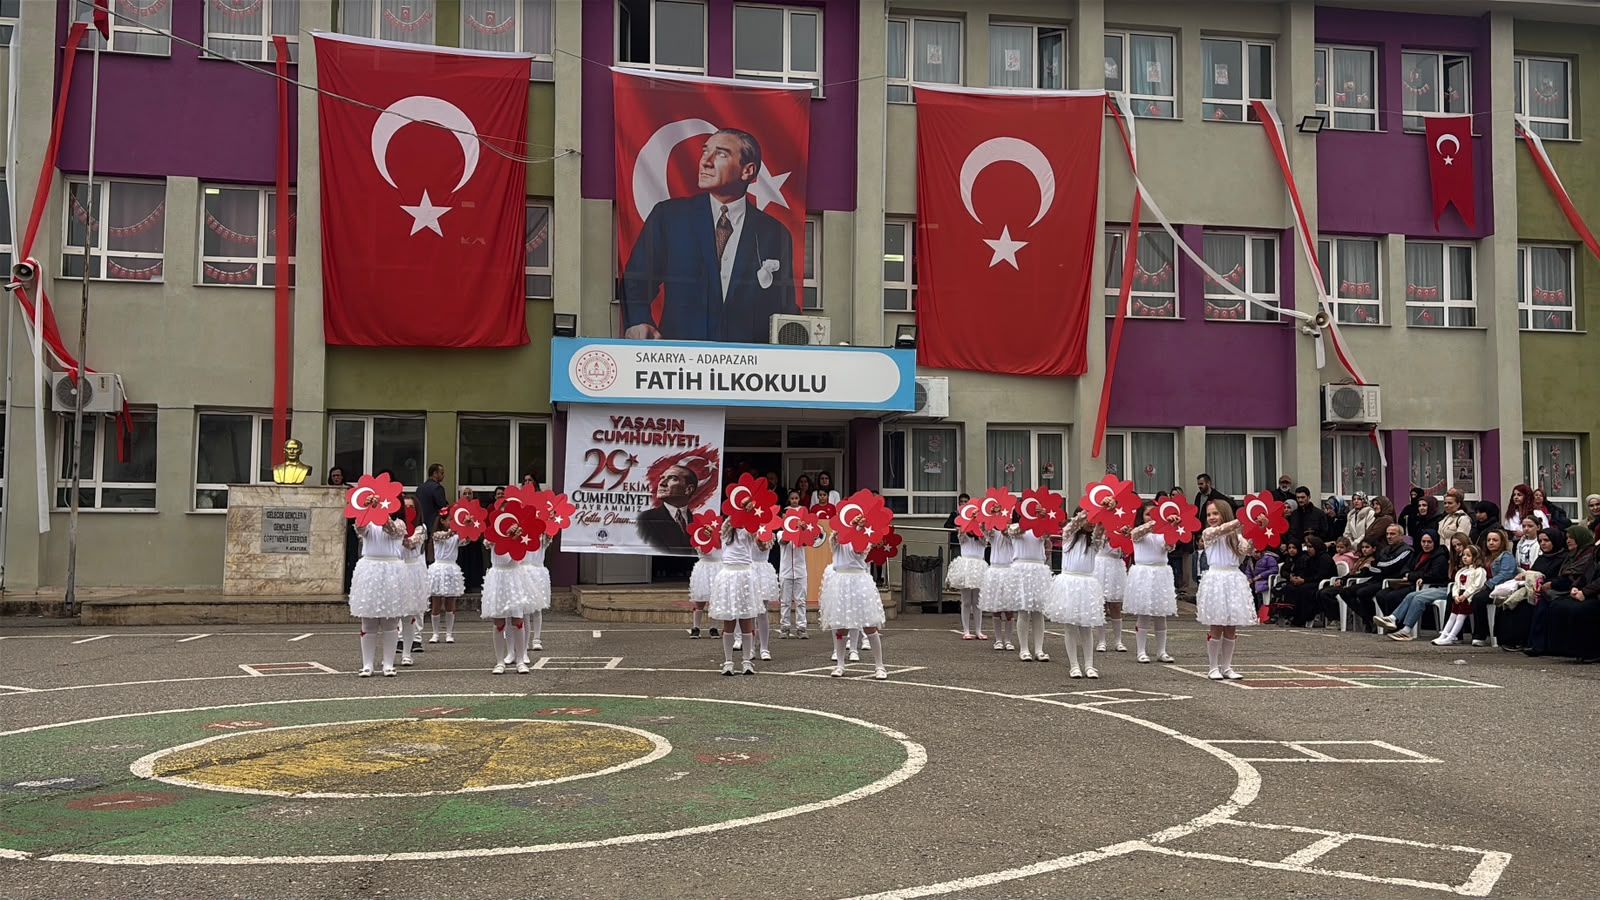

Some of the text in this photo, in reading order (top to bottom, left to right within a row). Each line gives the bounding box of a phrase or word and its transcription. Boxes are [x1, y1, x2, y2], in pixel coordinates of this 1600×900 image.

[635, 352, 686, 363] SAKARYA
[696, 353, 758, 365] ADAPAZARI
[635, 367, 702, 390] FATİH
[709, 368, 827, 393] İLKOKULU
[609, 415, 685, 432] YAŞASIN
[592, 429, 700, 447] CUMHURİYET!
[580, 448, 638, 491] 29
[623, 481, 651, 492] EKİM
[572, 490, 652, 506] CUMHURİYET
[575, 503, 642, 513] BAYRAMIMIZ
[575, 511, 601, 526] Kutlu
